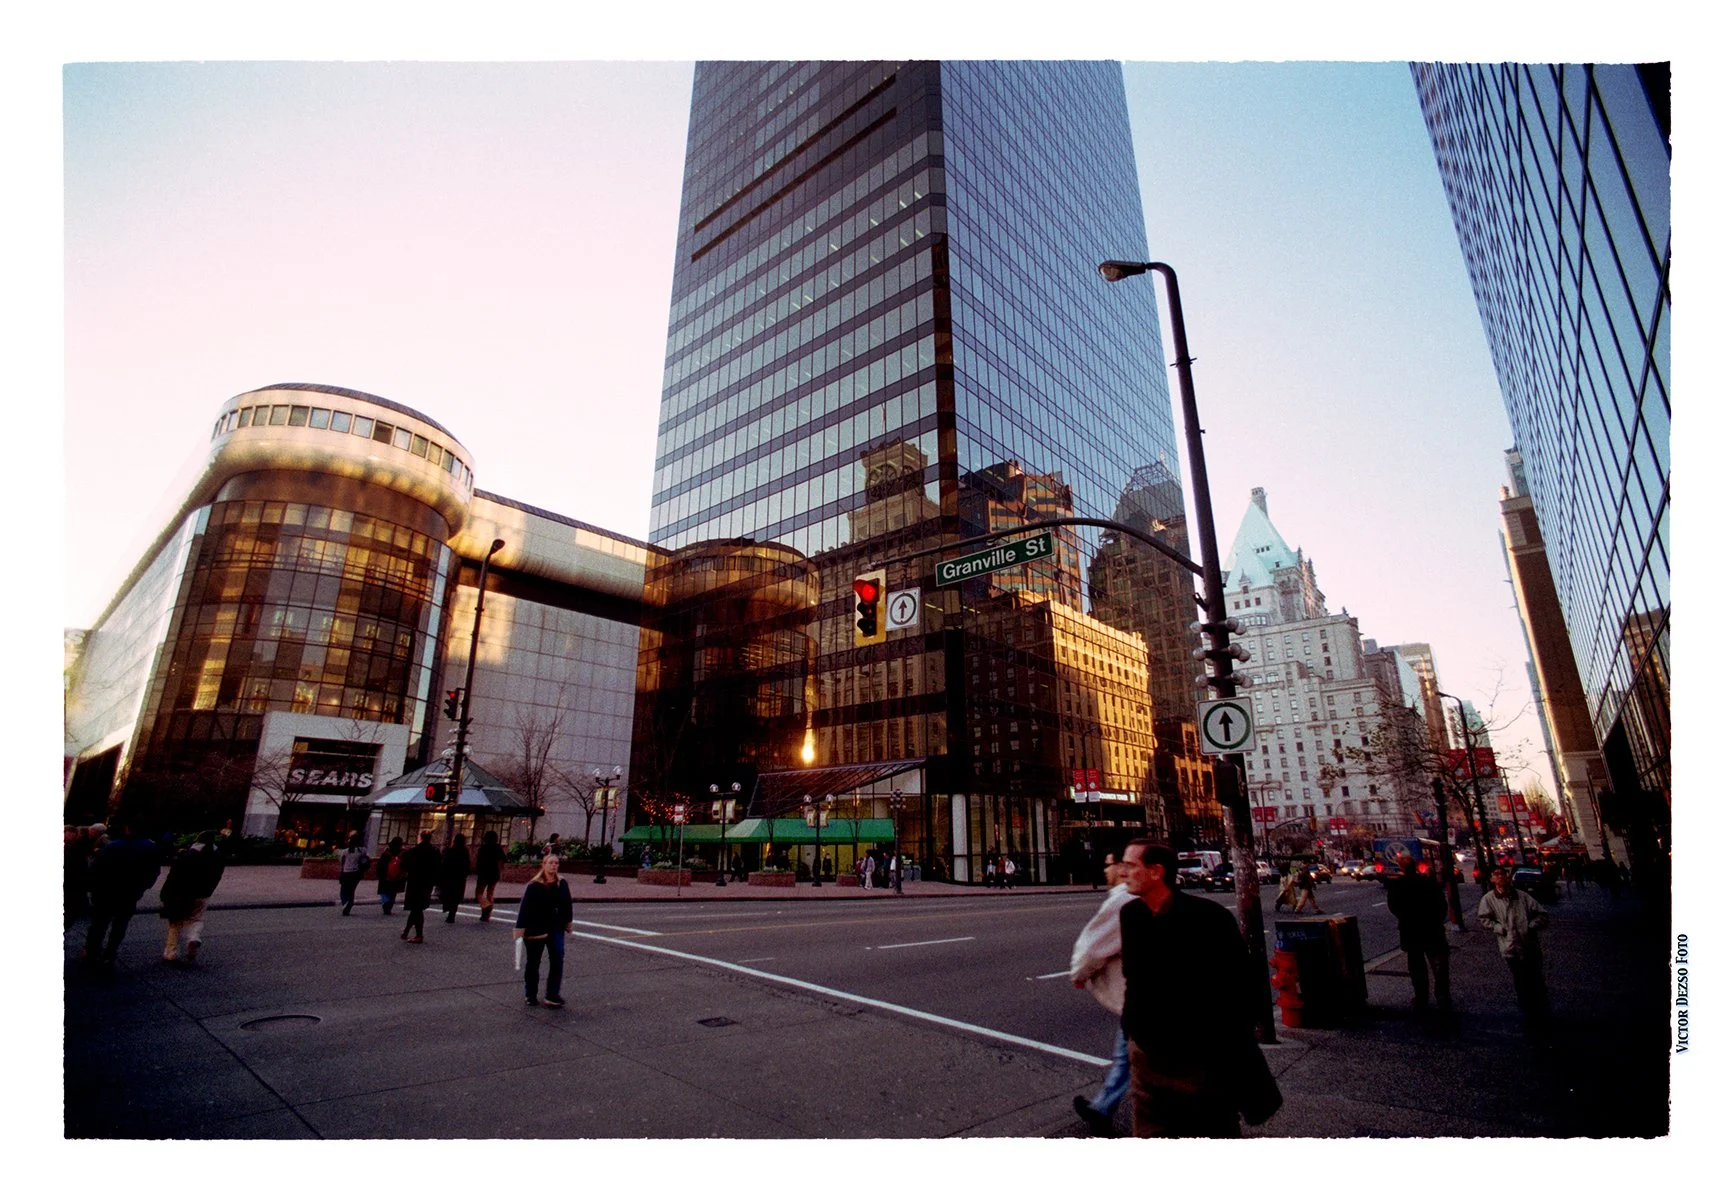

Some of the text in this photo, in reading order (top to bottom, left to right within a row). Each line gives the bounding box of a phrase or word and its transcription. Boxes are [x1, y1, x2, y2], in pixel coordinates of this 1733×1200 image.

[942, 538, 1046, 579] Granville St
[290, 768, 373, 788] SEARS
